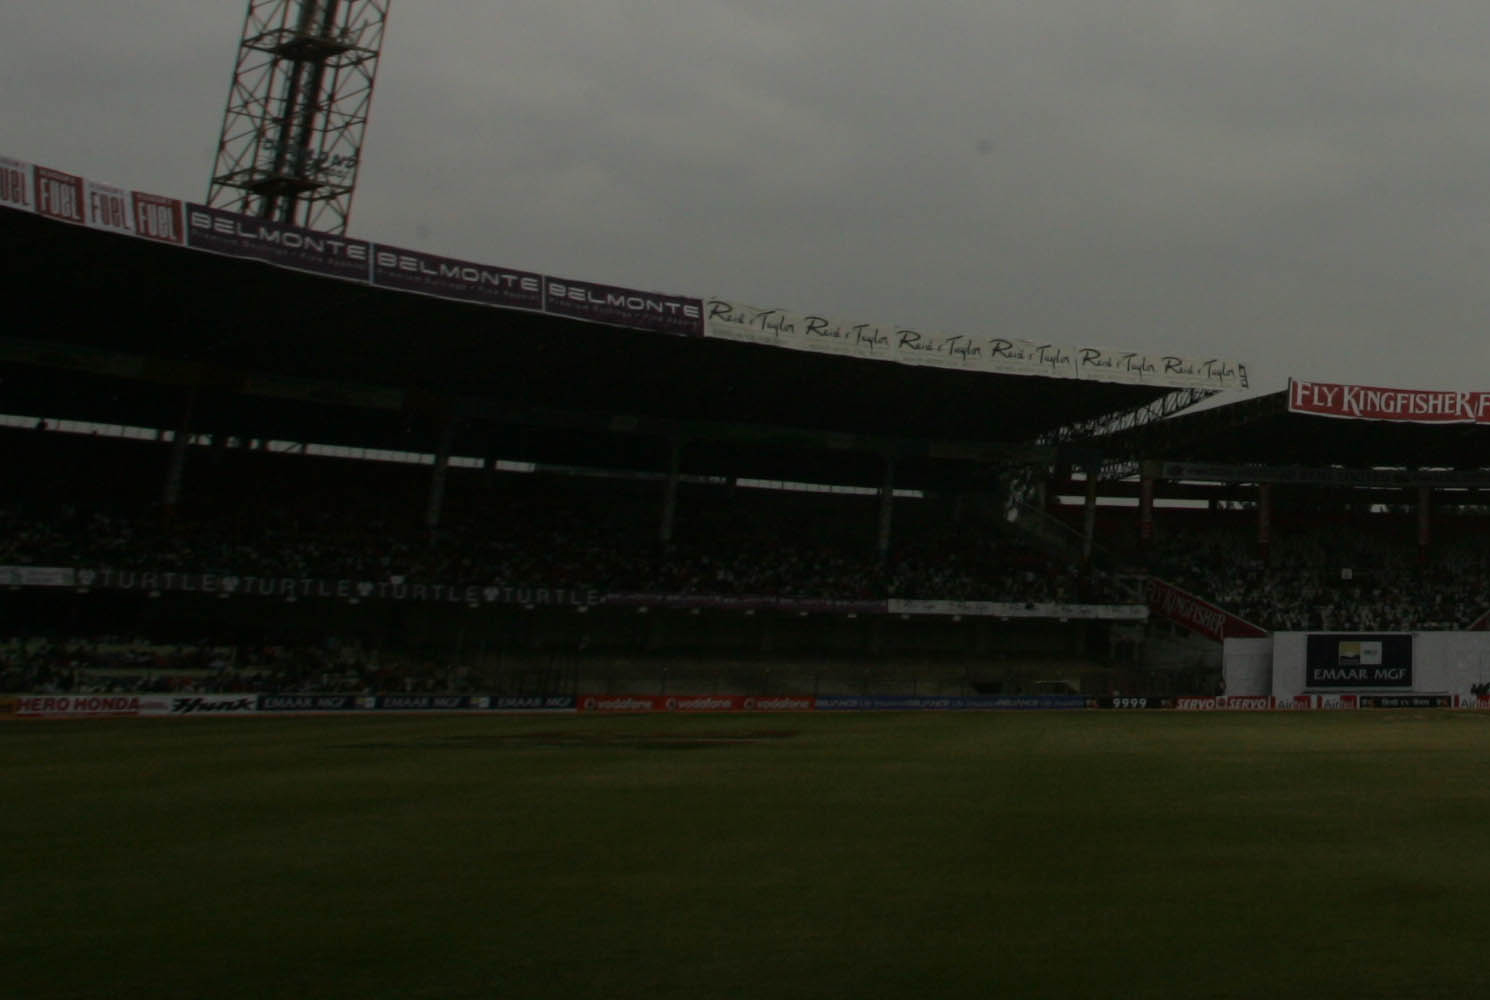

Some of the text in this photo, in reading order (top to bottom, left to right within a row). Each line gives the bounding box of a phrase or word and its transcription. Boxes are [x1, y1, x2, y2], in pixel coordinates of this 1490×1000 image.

[191, 211, 367, 261] BELMONTE
[377, 251, 539, 293] BELMONTE
[548, 282, 700, 319] BELMONTE
[757, 310, 794, 336] Taylor
[854, 324, 888, 349] Taylor
[946, 335, 981, 360] Taylor
[1036, 344, 1069, 368] Taylor
[1122, 353, 1154, 377] Taylor
[1204, 360, 1234, 381] Taylor
[1296, 381, 1475, 419] FLY KINGFISHER
[96, 568, 216, 593] TURTLE
[243, 576, 351, 598] TURTLE
[377, 582, 480, 602] TURTLE
[503, 587, 601, 606] TURTLE
[1313, 668, 1408, 681] EMAAR MGF
[17, 697, 139, 711] HERO HONDA
[172, 697, 256, 713] Hunk
[1112, 697, 1147, 708] 9999
[1176, 698, 1216, 710] SERVO
[1229, 698, 1267, 710] SERVO
